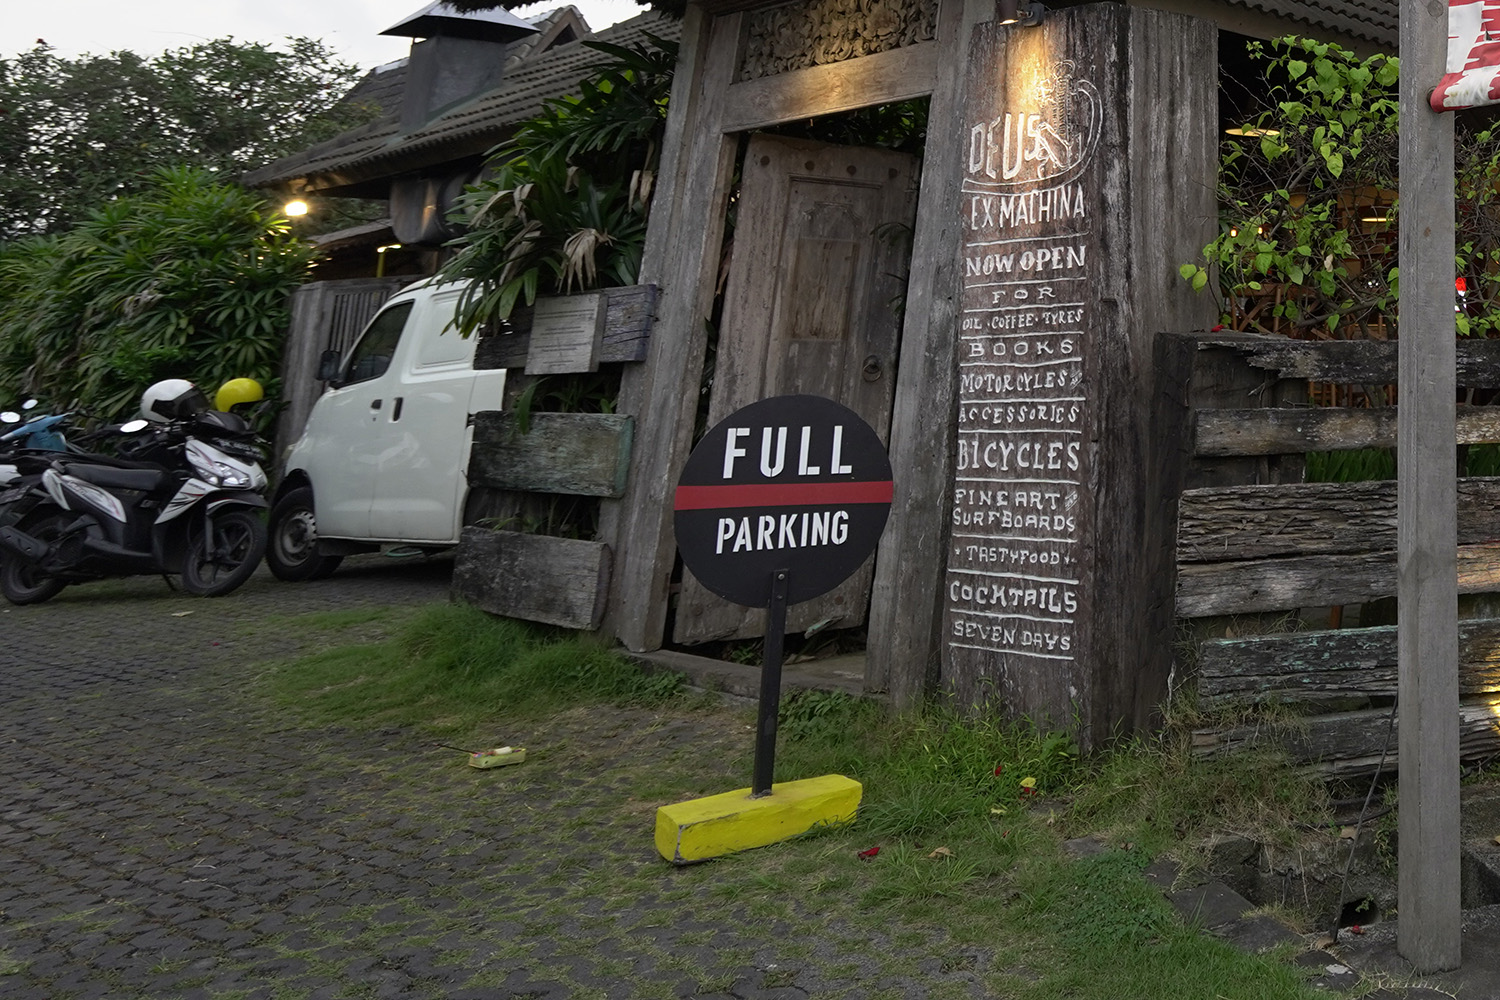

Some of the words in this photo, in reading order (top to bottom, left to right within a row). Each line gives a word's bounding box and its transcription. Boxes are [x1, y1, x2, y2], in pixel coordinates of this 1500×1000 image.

[969, 112, 1041, 180] DEUS
[971, 196, 994, 230] EX
[1000, 182, 1085, 228] MACHINA
[965, 253, 1015, 277] NOW
[1020, 245, 1087, 272] OPEN
[992, 286, 1056, 304] FOR
[962, 318, 983, 331] OIL
[991, 312, 1035, 330] COFFEE
[1042, 308, 1085, 326] TYRES
[968, 339, 1075, 358] BOOKS
[958, 404, 1080, 424] ACCESSORIES
[722, 425, 853, 479] FULL
[956, 438, 1080, 472] BICYCLES
[954, 488, 1009, 507] FINE
[1015, 490, 1061, 510] ART
[715, 510, 850, 555] PARKING
[952, 507, 1076, 532] SURFBOARDS
[949, 580, 1078, 614] COCKTAILS
[953, 620, 1017, 645] SEVEN
[1021, 630, 1072, 651] DAYS
